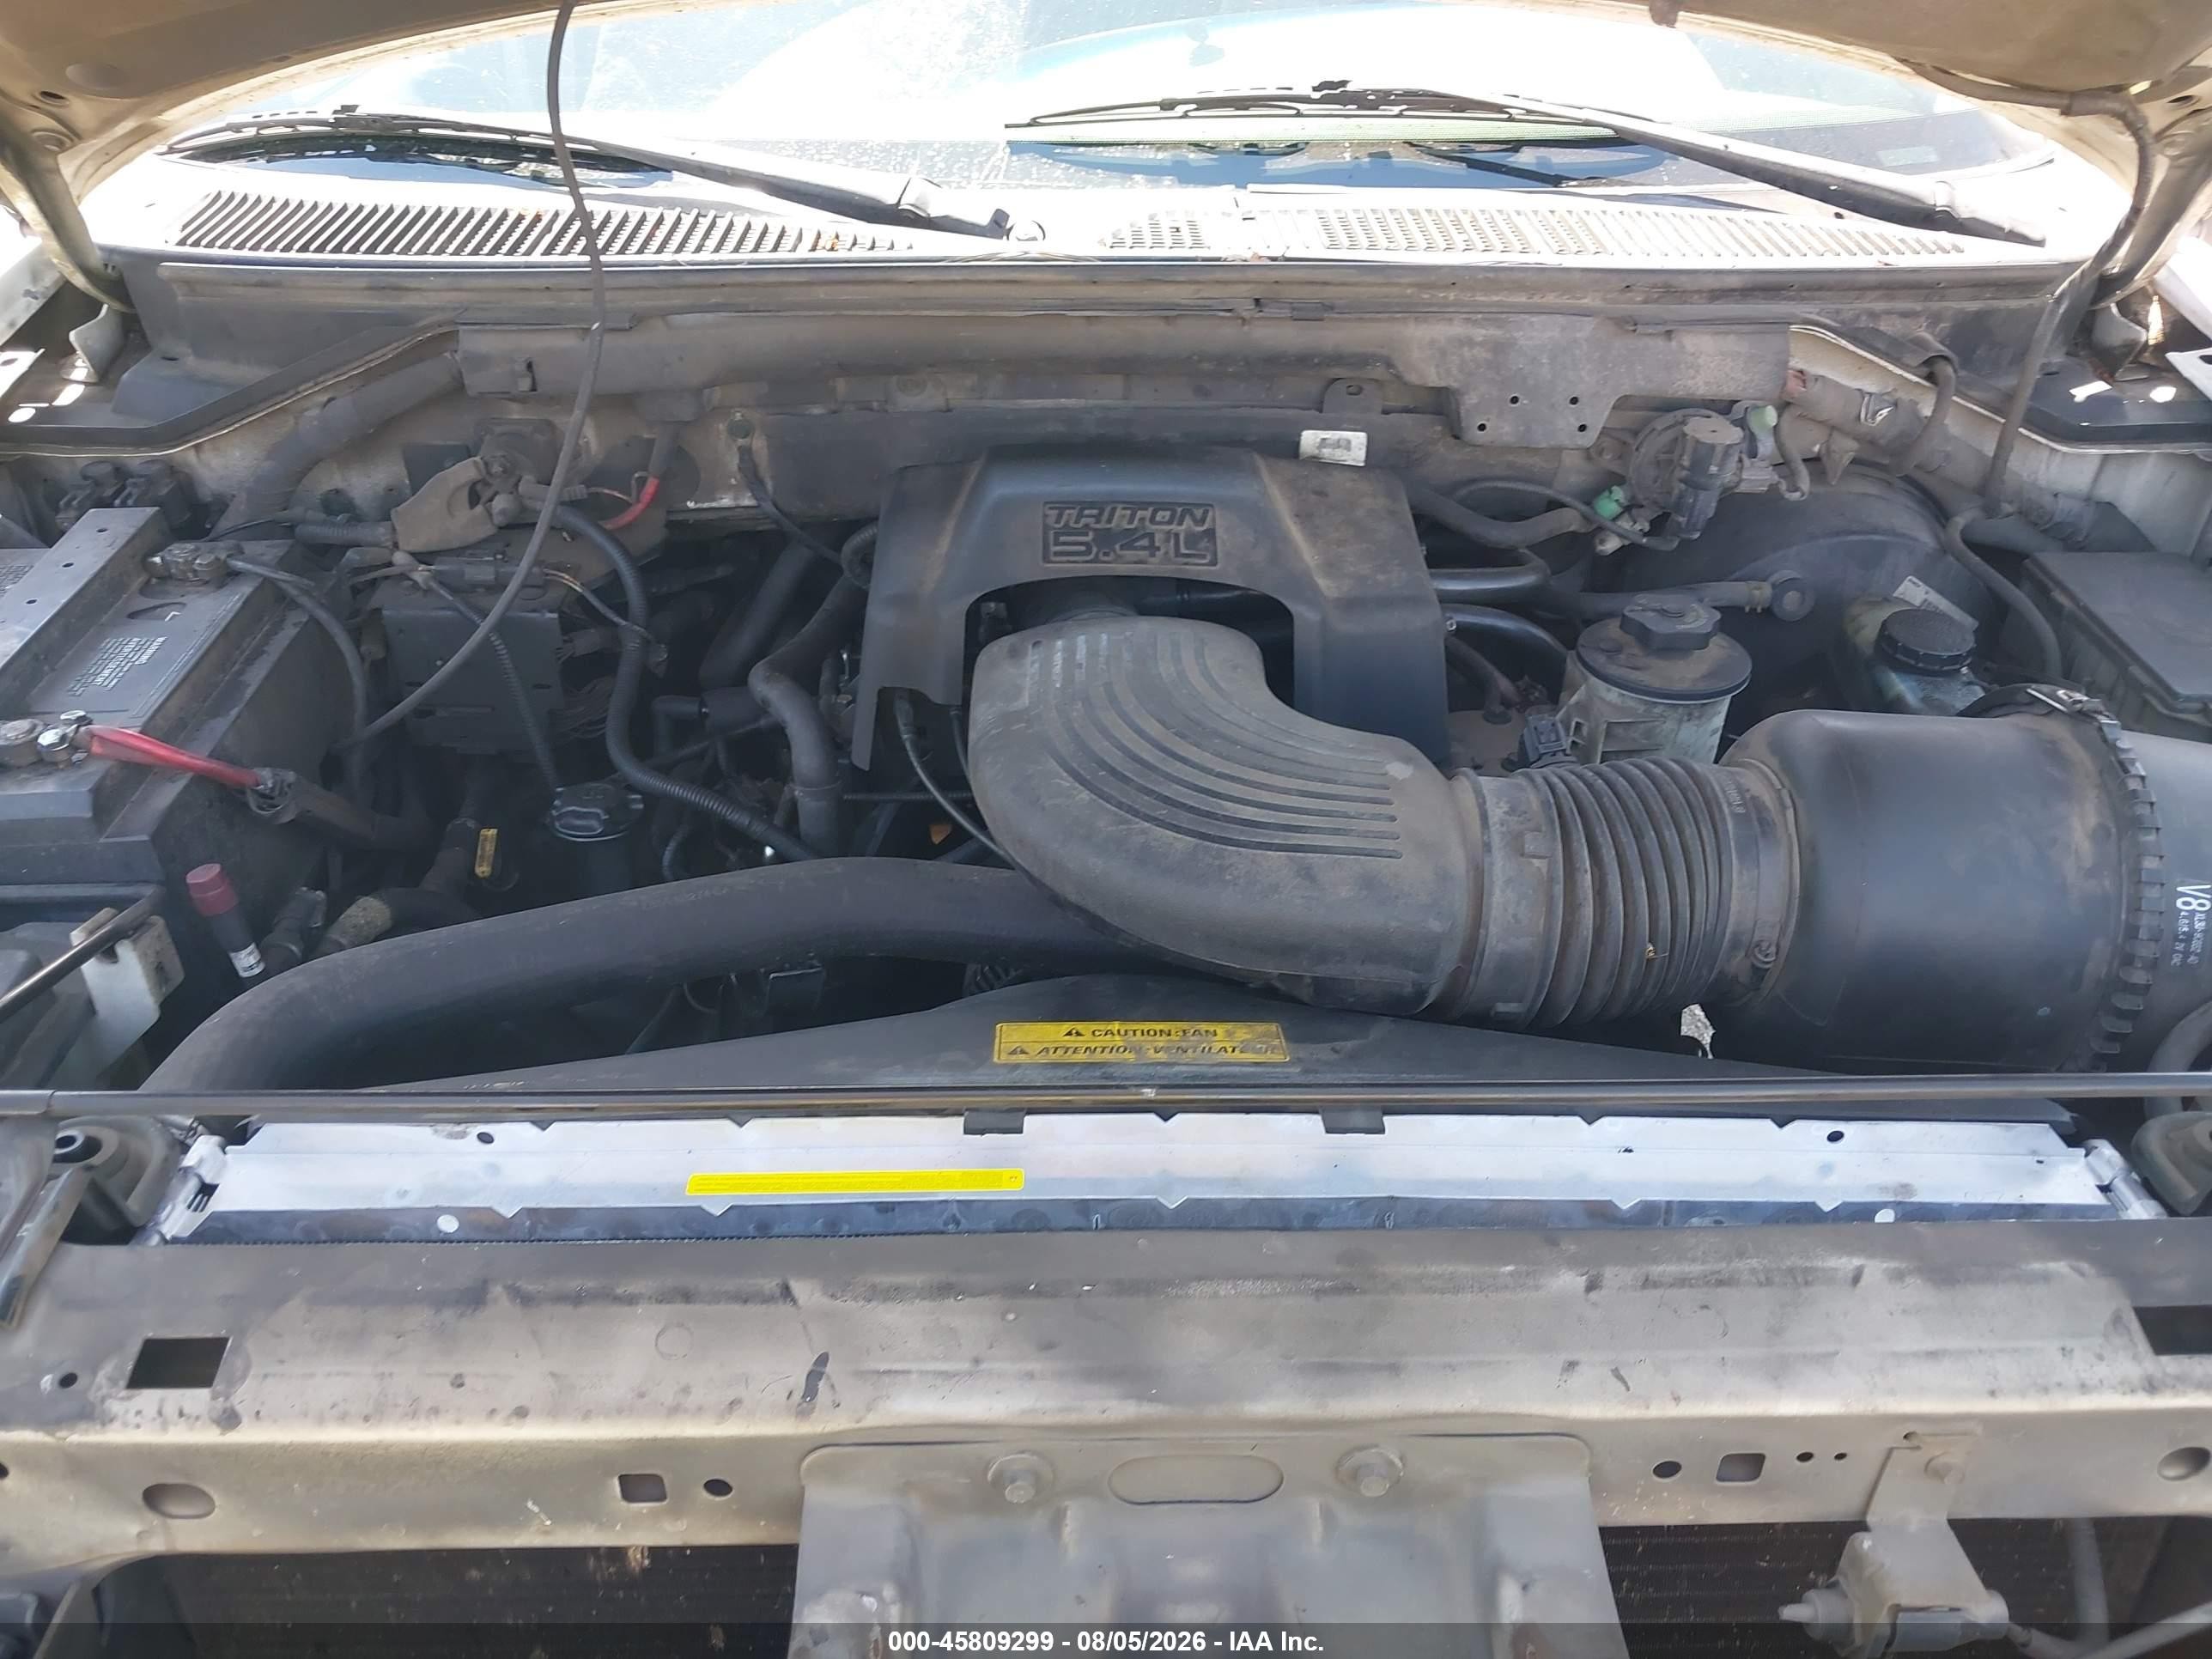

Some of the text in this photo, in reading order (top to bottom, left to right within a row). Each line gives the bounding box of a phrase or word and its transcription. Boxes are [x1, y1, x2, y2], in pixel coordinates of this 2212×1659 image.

[1048, 505, 1211, 528] TRITON
[1049, 530, 1212, 562] 5.4L
[2176, 884, 2212, 911] V8
